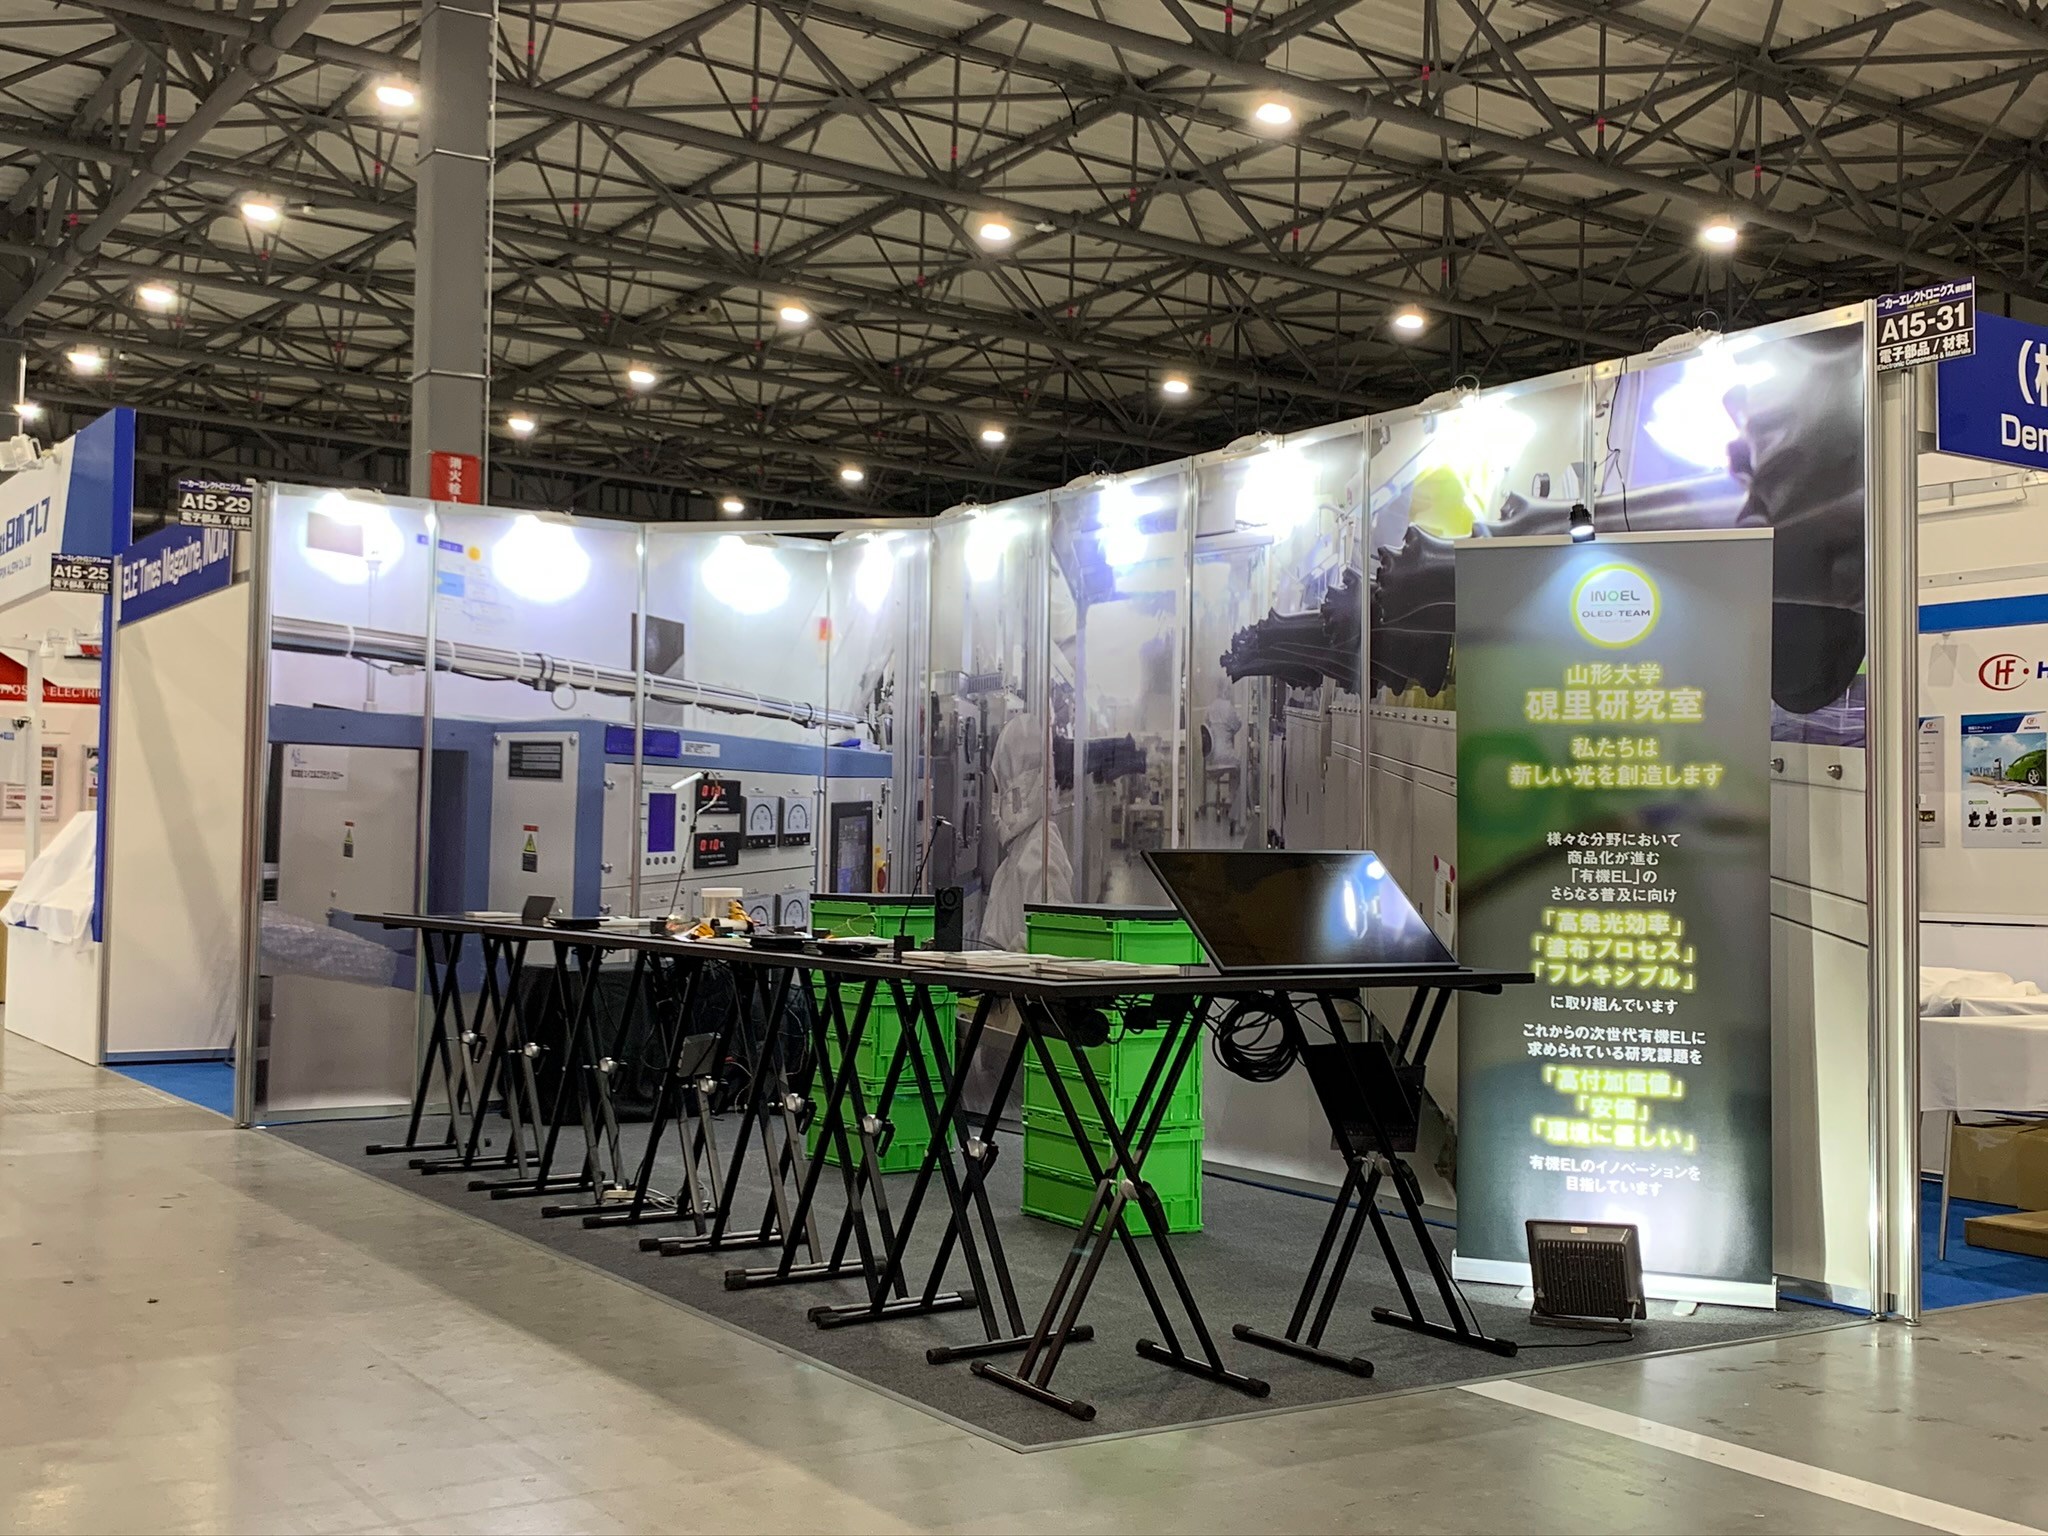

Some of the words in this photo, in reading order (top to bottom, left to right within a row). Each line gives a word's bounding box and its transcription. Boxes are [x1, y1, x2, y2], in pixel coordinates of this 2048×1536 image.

[1881, 302, 1965, 344] A15-31
[1879, 341, 1931, 363] 電子部品
[1942, 332, 1970, 351] 材料
[182, 492, 251, 513] A15-29
[53, 564, 109, 580] A15-25
[139, 558, 161, 594] Times
[1590, 590, 1641, 602] INOEL
[1566, 663, 1661, 685] 山形大学
[1526, 688, 1703, 720] 硯里研究室
[1572, 736, 1659, 758] 私たちは
[1509, 763, 1723, 786] 新しい光を創造します
[1546, 831, 1682, 847] 様々な分野において
[1567, 850, 1660, 866] 商品化が進む
[1571, 867, 1658, 884] 「有機EL」の
[1550, 886, 1678, 903] さらなる普及に向け
[1545, 910, 1682, 937] 「高発光効率」
[1535, 936, 1694, 963] 「塗布プロセス」
[1535, 962, 1694, 990] 「フレキシブル」
[1550, 995, 1679, 1014] に取り組んでいます
[1522, 1023, 1707, 1045] これからの次世代有機ELに
[1527, 1041, 1703, 1065] 求められている研究課題を
[1529, 1154, 1701, 1181] 有機ELのイノベーションを
[1565, 1175, 1663, 1197] 目指しています
